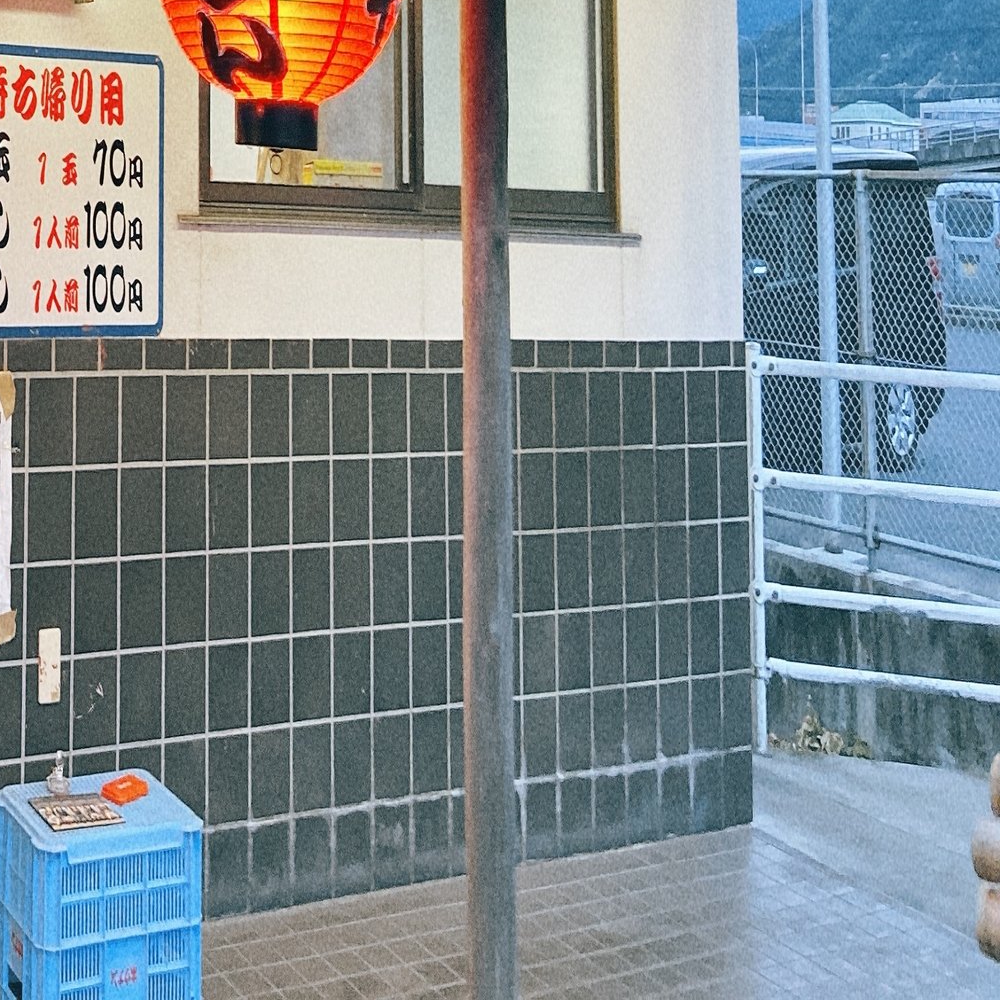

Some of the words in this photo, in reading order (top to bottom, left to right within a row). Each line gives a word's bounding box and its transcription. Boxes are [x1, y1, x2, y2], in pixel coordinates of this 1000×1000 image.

[93, 139, 144, 189] 70円
[84, 201, 144, 251] 100円
[84, 264, 144, 313] 100円
